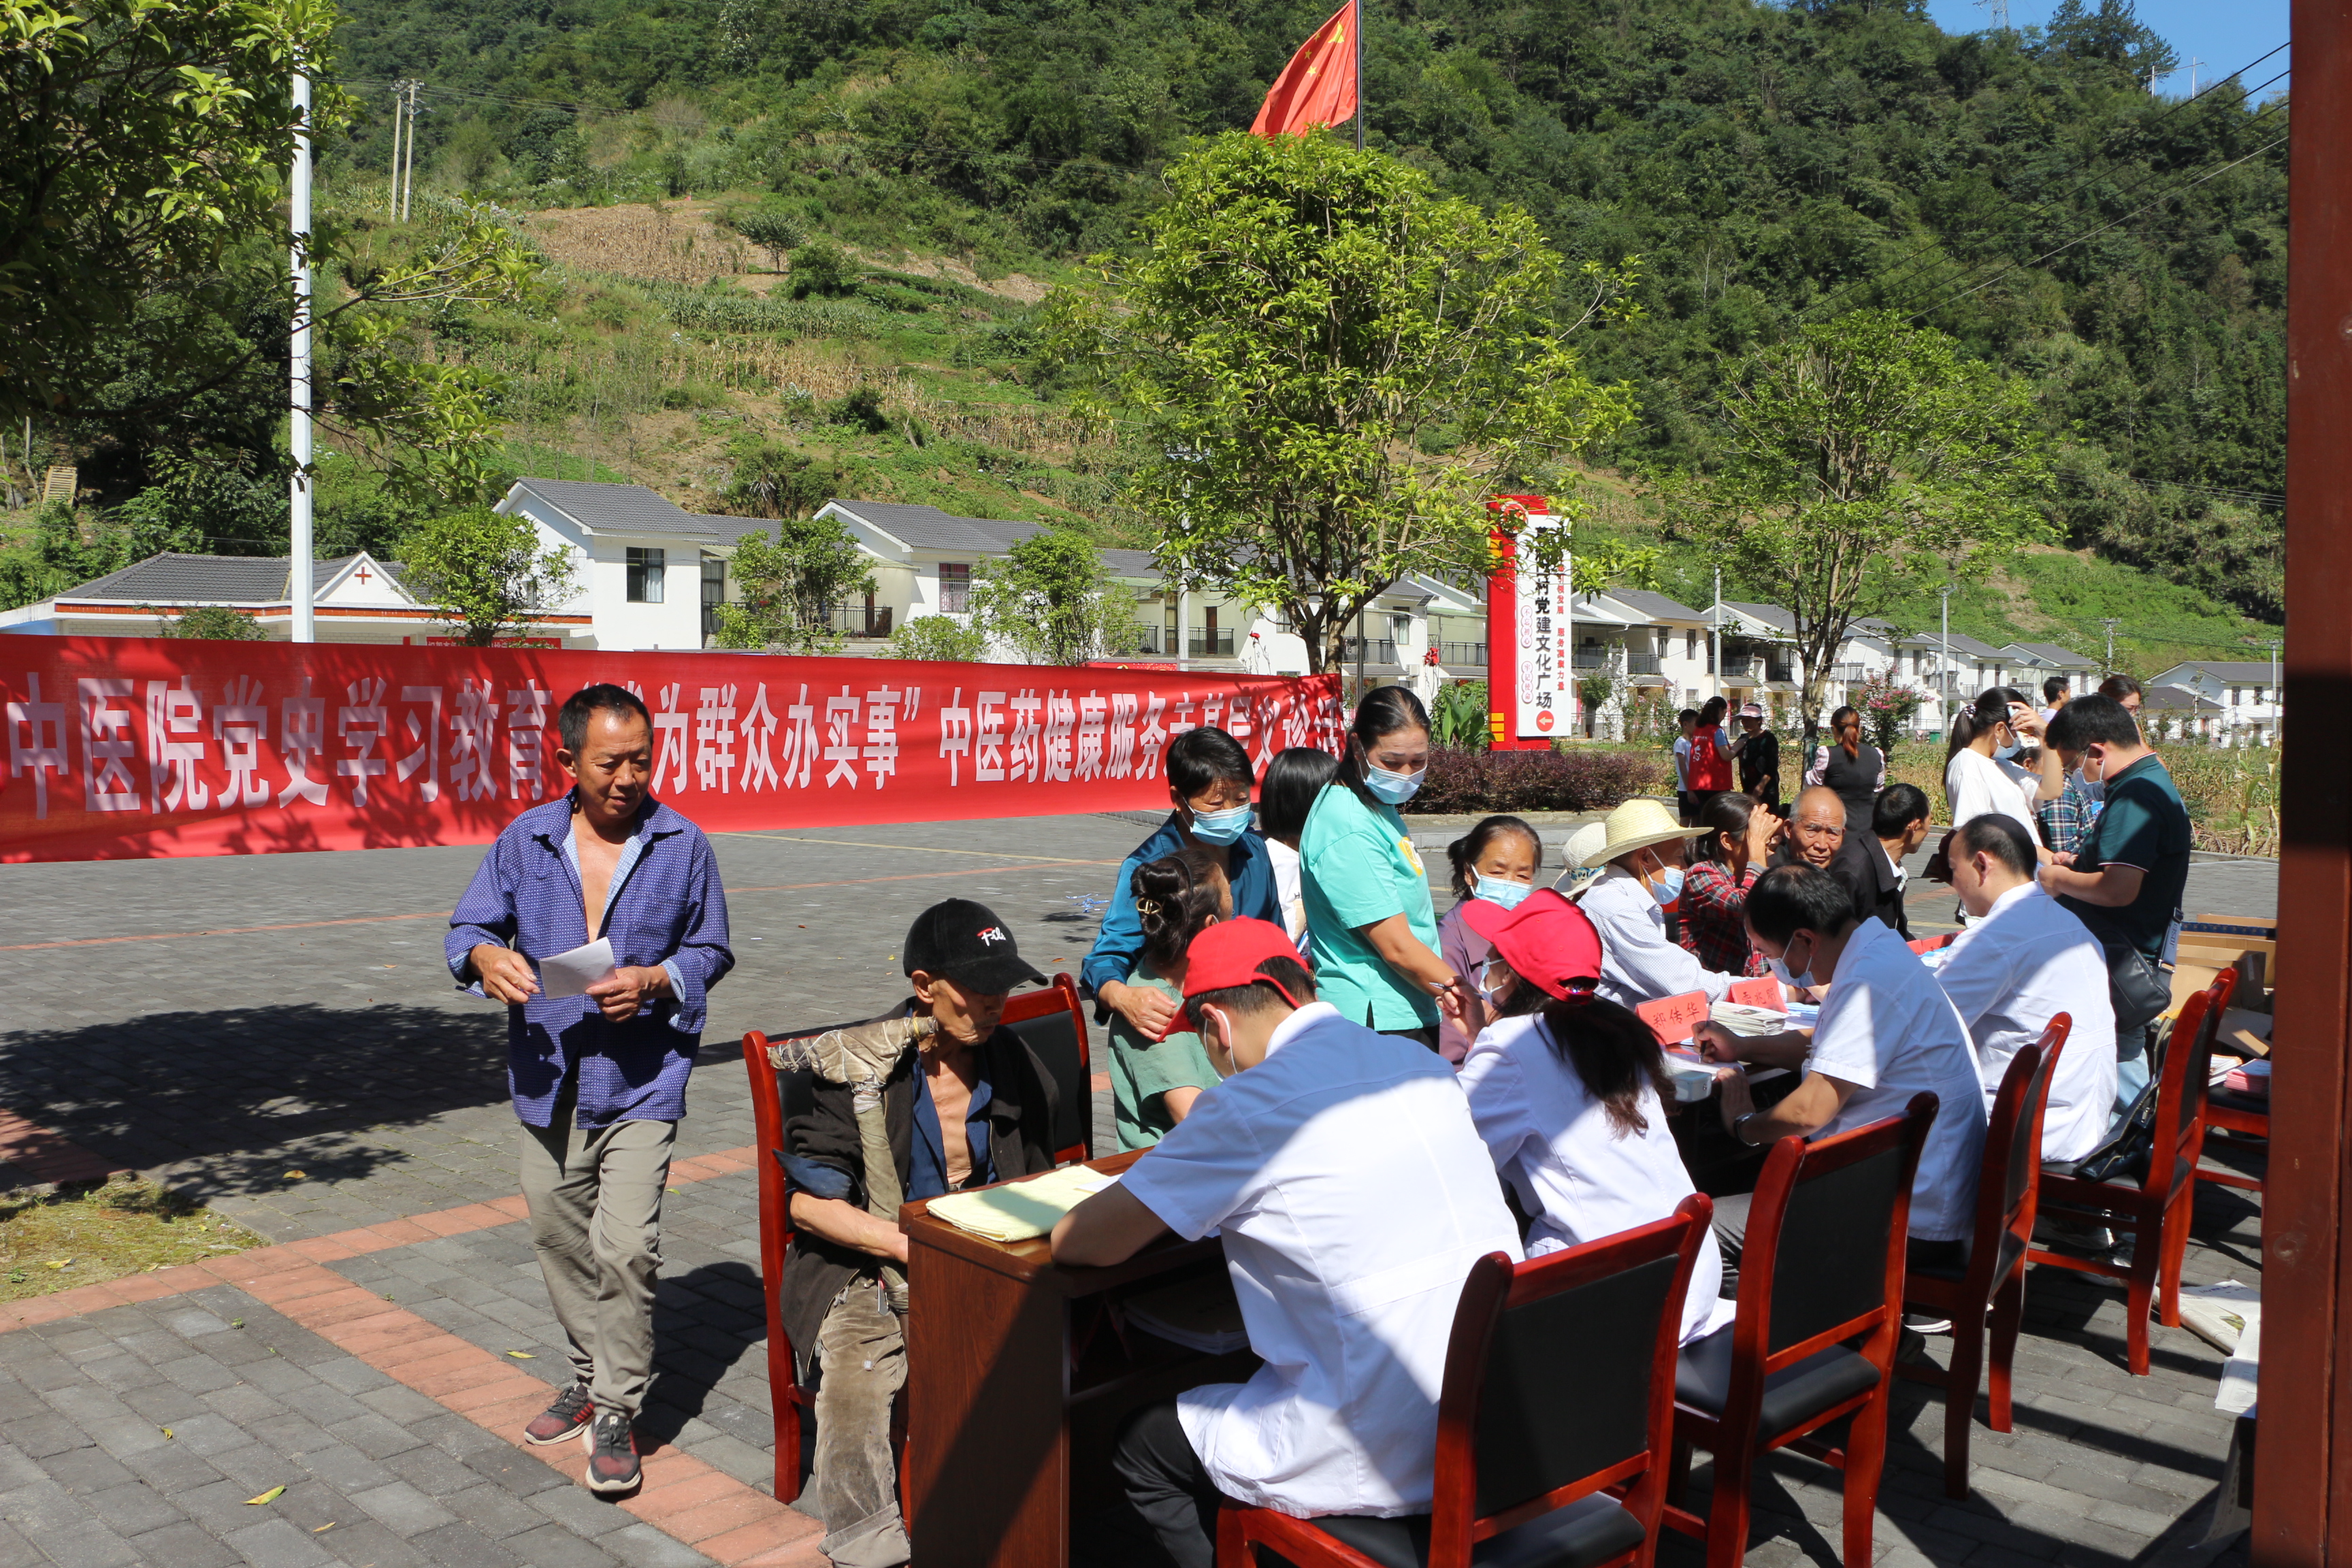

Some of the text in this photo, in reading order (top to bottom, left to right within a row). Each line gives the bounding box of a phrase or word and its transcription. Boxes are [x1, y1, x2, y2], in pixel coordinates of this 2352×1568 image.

[1535, 527, 1552, 709] 村党建文化广场
[7, 672, 552, 819] 中医院党史学习教育
[1653, 1002, 1700, 1029] 郑传华
